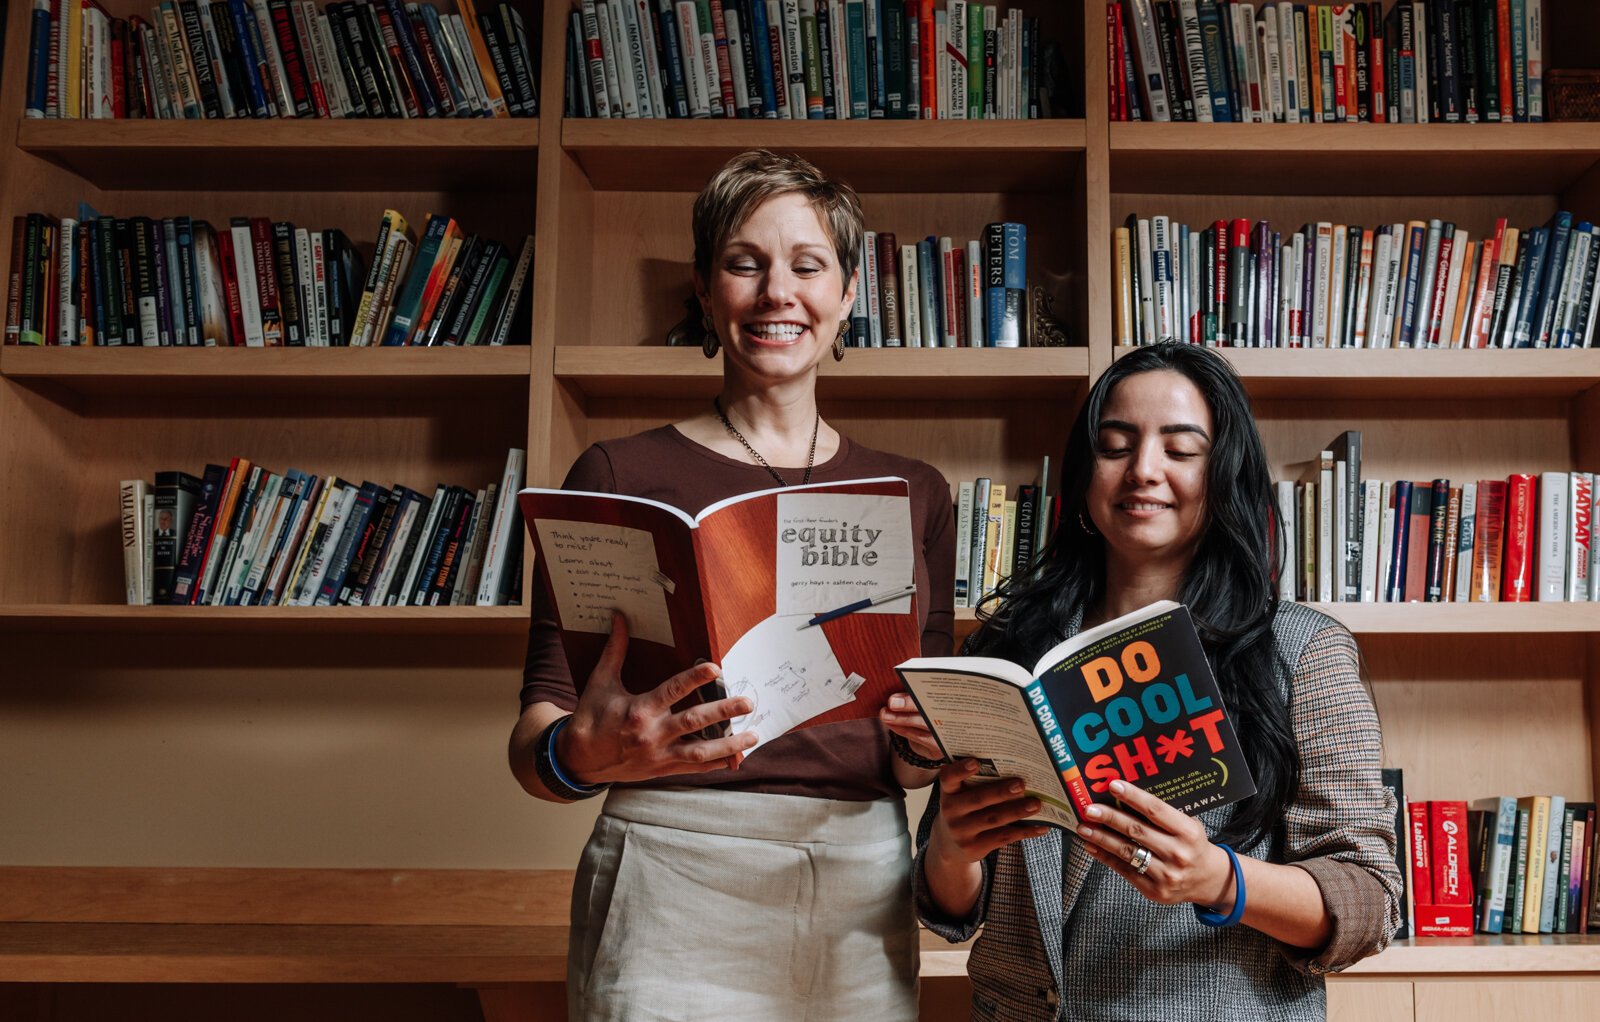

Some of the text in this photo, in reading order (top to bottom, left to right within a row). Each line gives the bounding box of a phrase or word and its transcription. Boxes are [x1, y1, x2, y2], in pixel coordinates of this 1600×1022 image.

[190, 37, 211, 84] DISCIPLINE
[487, 32, 512, 91] THE MIRROR TEST
[628, 23, 646, 89] INNOVATION
[819, 23, 833, 96] Beyond Booked Solid
[1185, 16, 1208, 99] SOCIAL MARKETING
[1286, 41, 1294, 76] Excellence
[1402, 12, 1413, 89] MARKETING STRATEGY
[1442, 12, 1454, 77] Strategic Marketing
[1515, 31, 1523, 55] OCEAN
[361, 67, 377, 96] START
[703, 40, 717, 87] innovation
[769, 27, 786, 106] GO FOR GROWTH
[1358, 51, 1367, 91] net gain
[1515, 59, 1523, 96] STRATEGY
[137, 222, 149, 293] STRATEGY SAFARI
[367, 226, 389, 288] Statistics Workbook
[991, 225, 1002, 285] PETERS
[1008, 227, 1019, 260] TOM
[1440, 242, 1449, 258] The
[61, 244, 70, 285] McKINSEY
[256, 242, 269, 307] STRATEGY ANALYSIS
[262, 241, 275, 296] CONTEMPORARY
[391, 262, 399, 274] MAKE
[1411, 254, 1419, 280] BUILDING
[1437, 260, 1448, 287] Global
[1578, 240, 1600, 328] MONEYHUNT
[228, 282, 240, 314] STRATEGY
[366, 244, 396, 326] FREE TRADE UNDER FIRE
[384, 281, 394, 302] HAPPEN
[1494, 266, 1510, 311] SATISFACTION
[122, 485, 135, 548] VALUATION
[472, 501, 482, 519] Team
[482, 503, 493, 522] Living
[1322, 499, 1332, 537] Vegetarian
[1517, 483, 1525, 514] LOOKING
[1576, 477, 1590, 550] MAYDAY
[180, 504, 207, 568] Management
[190, 514, 212, 558] Strategic
[550, 530, 575, 540] Think
[606, 538, 629, 549] ready
[782, 522, 882, 548] equity
[1434, 505, 1446, 545] VENTURE
[1446, 497, 1459, 558] GETTING LEAN
[1462, 518, 1471, 547] GOAL
[1517, 532, 1525, 546] SUN
[435, 540, 458, 588] TECHNO VISION
[558, 555, 614, 568] Learn about
[801, 545, 878, 566] bible
[1053, 656, 1078, 672] FOREWORD
[1087, 644, 1100, 653] TONY
[1139, 614, 1172, 630] ZAPPOS.COM
[1064, 664, 1074, 672] AND
[1075, 652, 1095, 666] AUTHOR
[1104, 635, 1134, 651] DELIVERING
[1134, 623, 1164, 638] HAPPINESS
[1080, 641, 1161, 704] DO
[1028, 686, 1045, 706] DO
[1072, 673, 1213, 753] COOL
[1036, 704, 1058, 735] COOL
[1072, 782, 1084, 797] MIKI
[1154, 780, 1172, 790] YOUR
[1172, 776, 1185, 784] DAY
[1186, 770, 1202, 779] JOB,
[1166, 785, 1180, 794] OWN
[1181, 773, 1212, 787] BUSINESS
[1178, 779, 1216, 797] EVER AFTER
[1177, 793, 1224, 813] GRAWAL
[1414, 822, 1425, 868] Labware
[1448, 835, 1458, 896] ALDRICH
